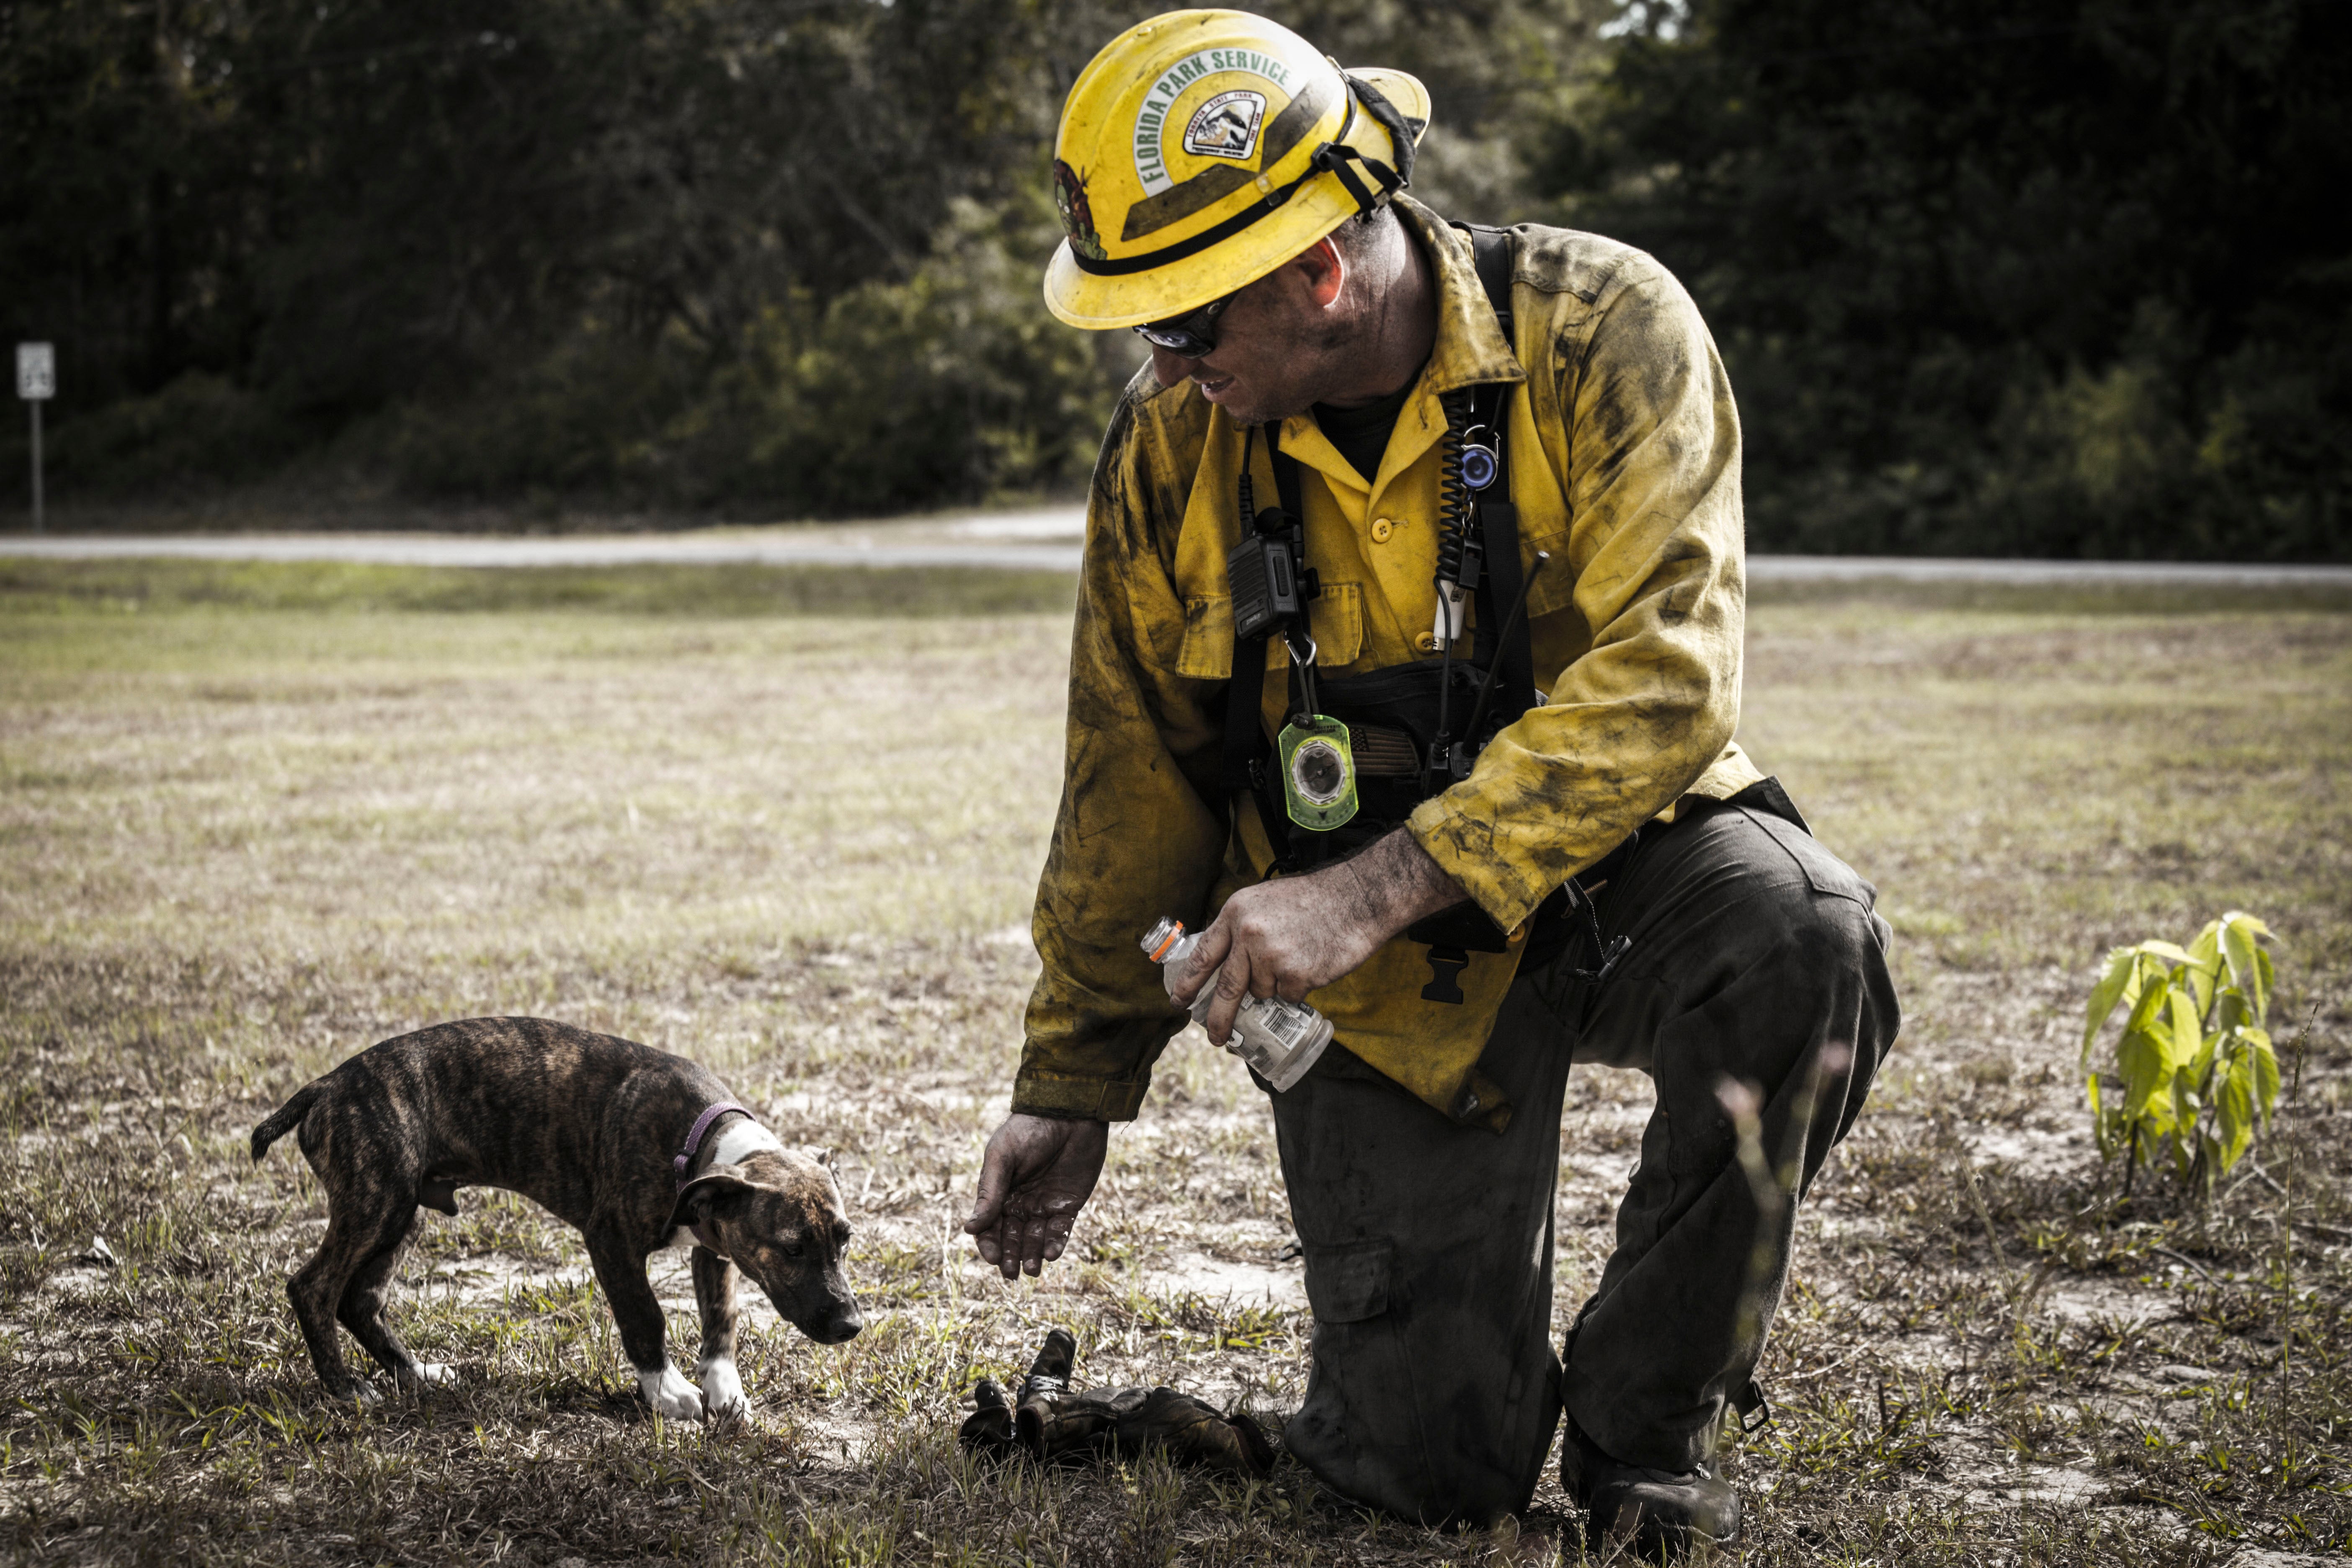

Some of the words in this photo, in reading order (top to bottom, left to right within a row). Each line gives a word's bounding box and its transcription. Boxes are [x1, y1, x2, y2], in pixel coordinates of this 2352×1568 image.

[1137, 100, 1168, 183] FLORIDA
[1157, 57, 1207, 97] PARK
[1211, 50, 1291, 85] SERVICE
[1209, 96, 1228, 108] STATE
